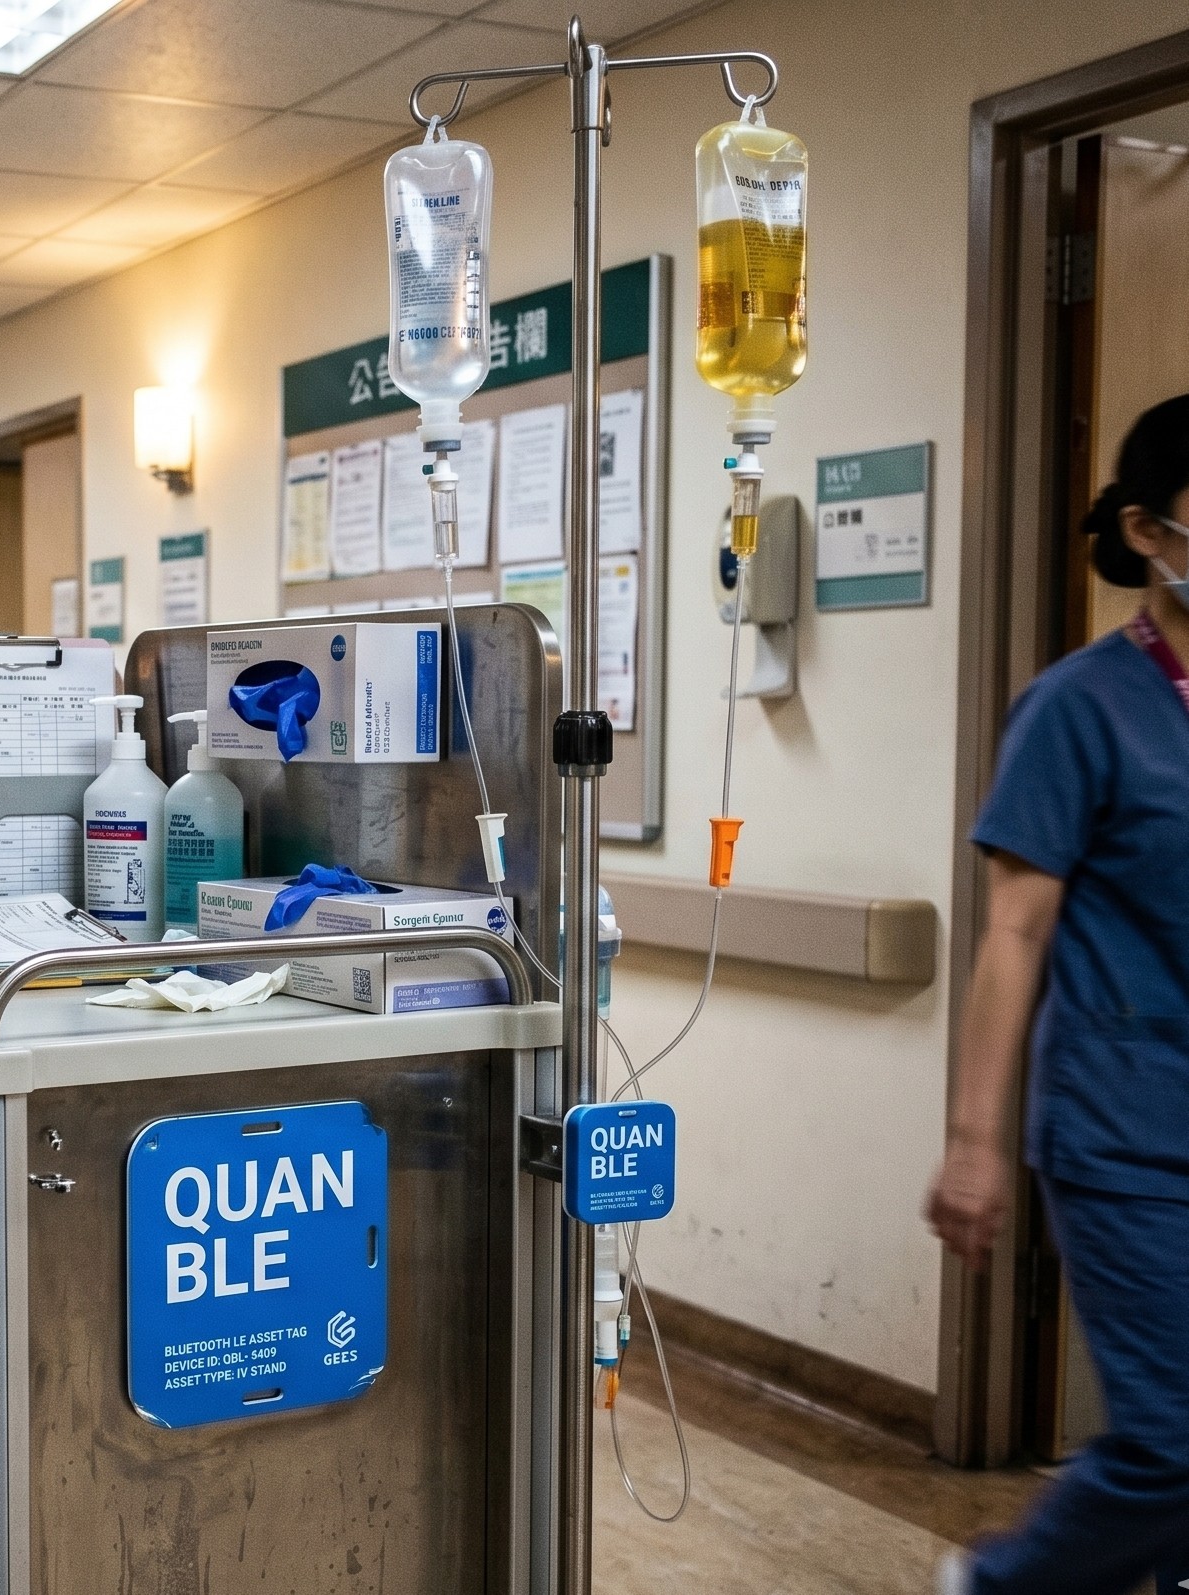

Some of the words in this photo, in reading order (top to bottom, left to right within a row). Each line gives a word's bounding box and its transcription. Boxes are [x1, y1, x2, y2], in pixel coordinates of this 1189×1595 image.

[590, 1123, 663, 1154] QUAN
[591, 1152, 638, 1180] BLE
[164, 1149, 354, 1235] QUAN
[166, 1229, 290, 1304] BLE
[164, 1337, 231, 1357] BLUETOOTH
[233, 1335, 247, 1347] LE
[249, 1329, 284, 1345] ASSET
[286, 1326, 308, 1339] TAG
[164, 1357, 205, 1374] DEVICE
[207, 1355, 221, 1368] ID:
[251, 1347, 277, 1360] 5409
[323, 1350, 358, 1366] GEES
[164, 1374, 202, 1391] ASSET
[203, 1370, 235, 1385] TYPE:
[236, 1367, 248, 1380] IV
[250, 1361, 287, 1377] STAND
